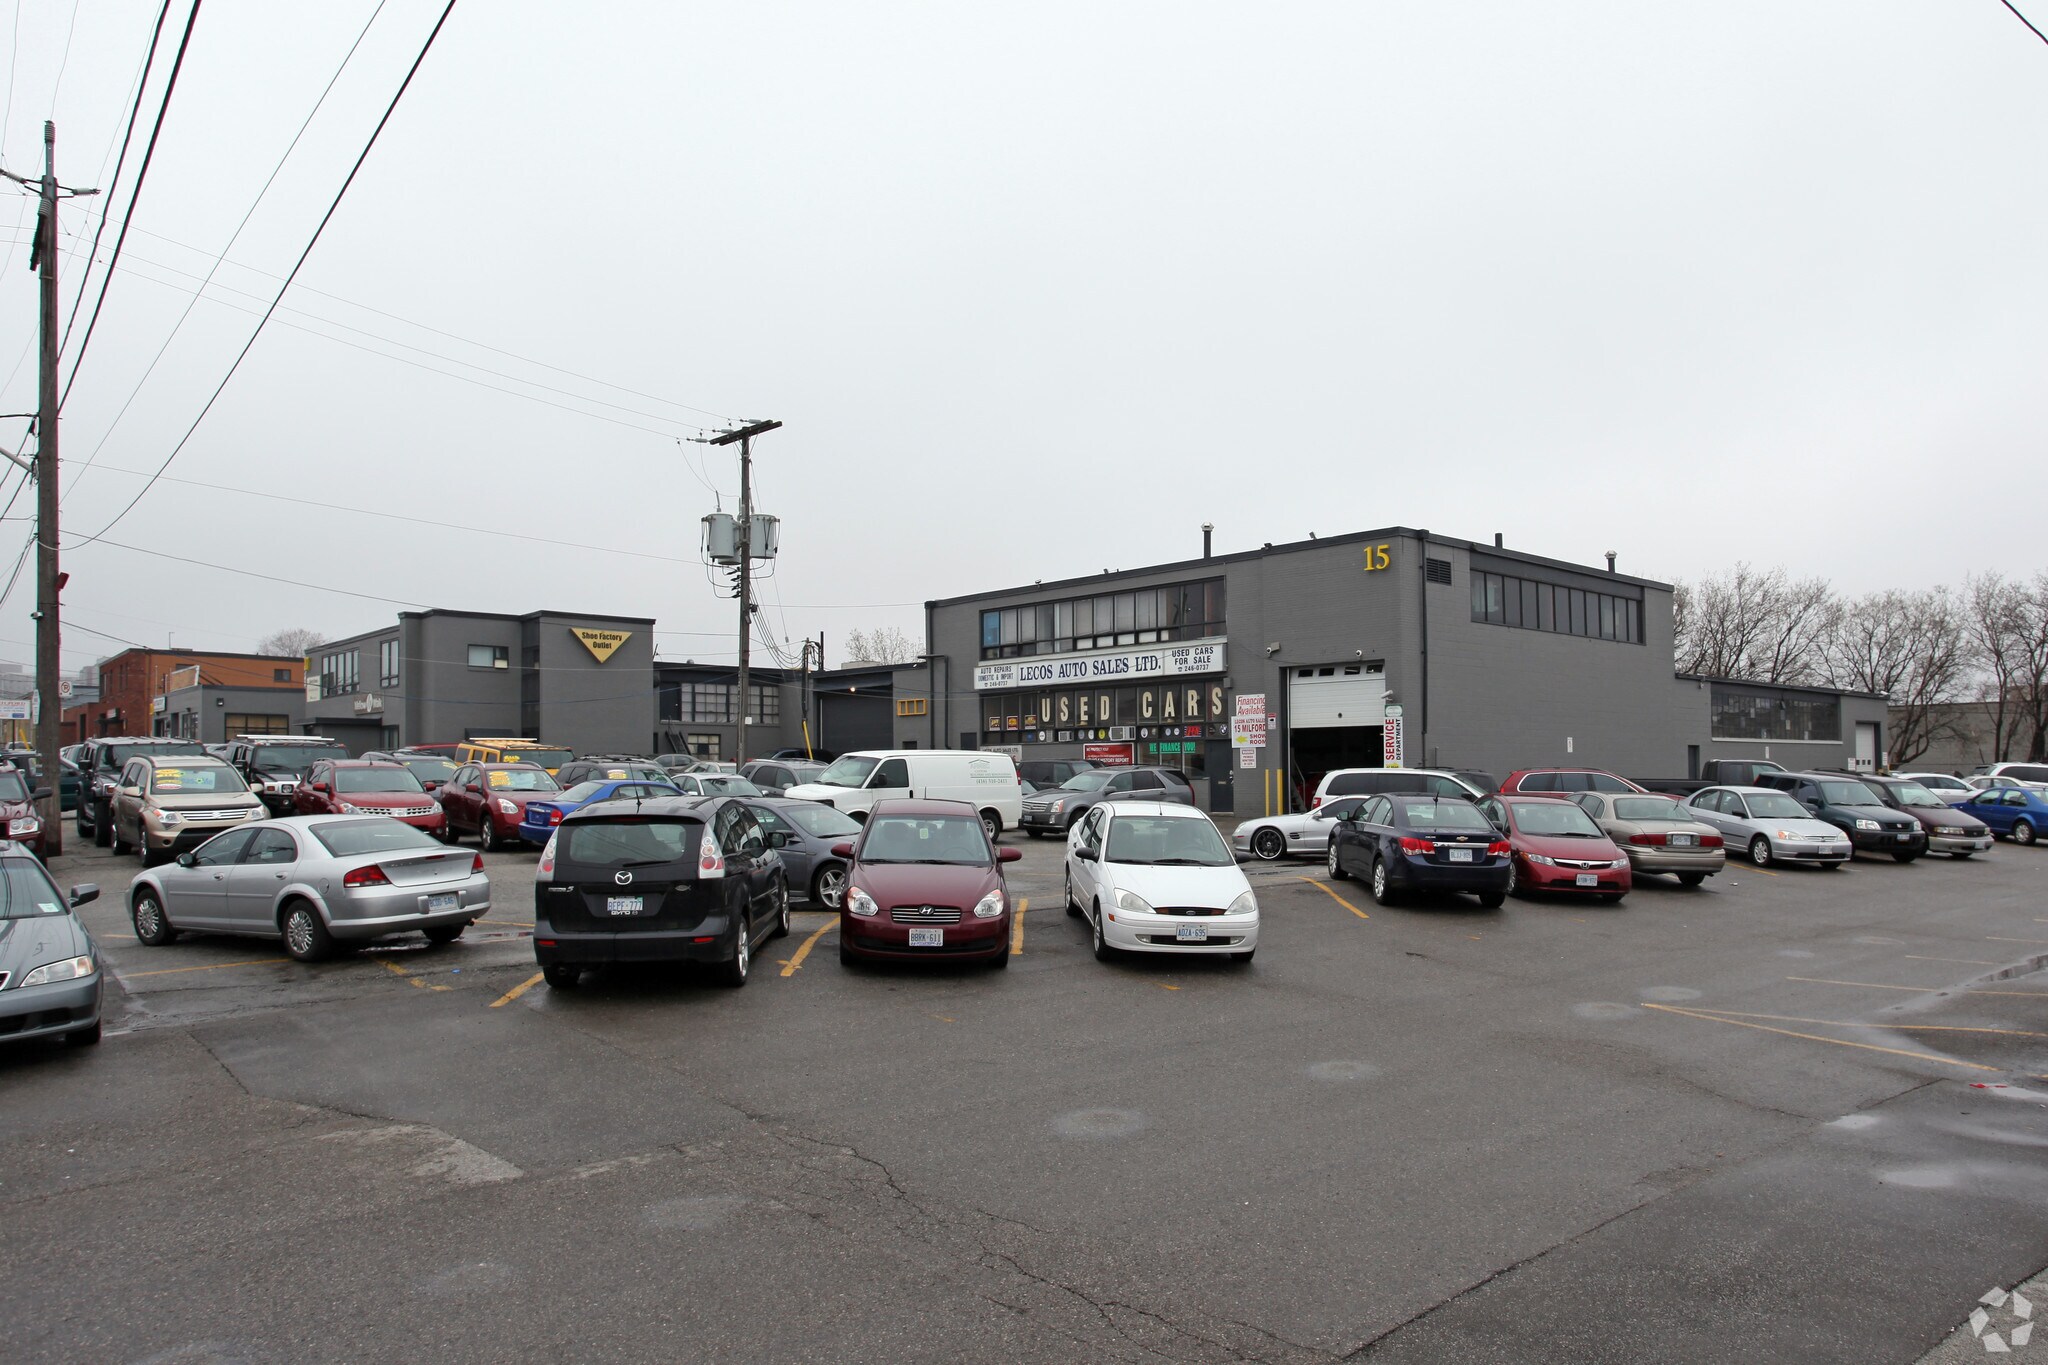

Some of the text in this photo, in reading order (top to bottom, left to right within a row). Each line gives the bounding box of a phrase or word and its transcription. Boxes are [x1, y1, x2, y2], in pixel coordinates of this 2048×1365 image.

[1363, 544, 1390, 571] 15
[581, 631, 623, 641] Shoe Factory
[592, 641, 612, 649] Outlet
[1171, 646, 1214, 658] USED CARS
[1174, 655, 1211, 666] FOR SALE
[980, 665, 1012, 675] AUTO REPAIRS
[1019, 655, 1161, 681] LECOS AUTO SALES LTD.
[1041, 695, 1110, 723] USED
[1142, 687, 1223, 718] CARS
[1234, 723, 1266, 733] 15 MILFORD
[1385, 719, 1395, 761] SERVICE
[1149, 742, 1196, 752] WE FINANCE YOU!
